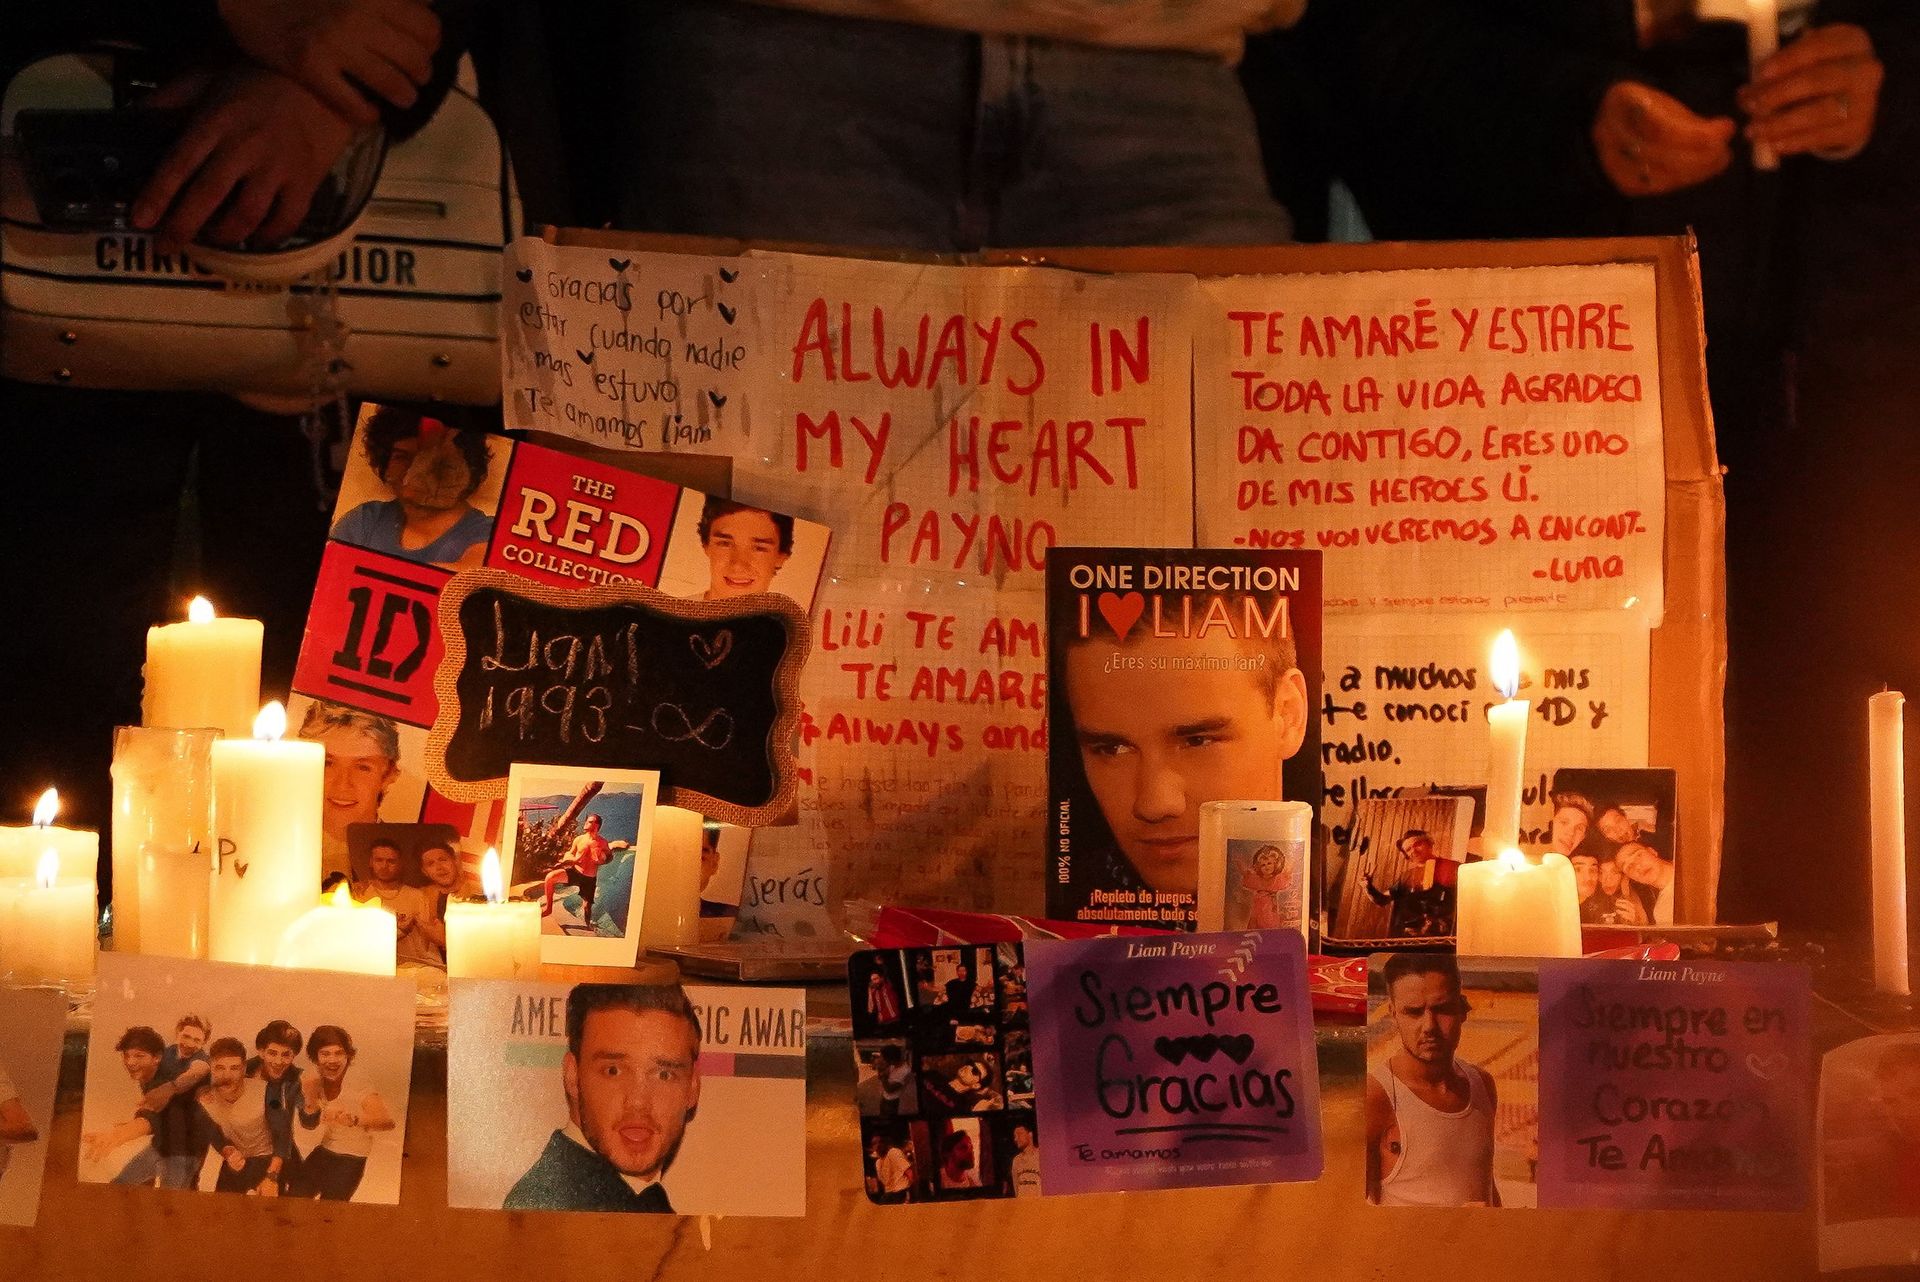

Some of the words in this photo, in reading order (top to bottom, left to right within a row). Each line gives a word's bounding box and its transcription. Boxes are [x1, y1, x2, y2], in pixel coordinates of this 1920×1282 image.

[548, 271, 634, 311] Gracias
[658, 289, 709, 321] por
[520, 302, 568, 336] estar
[1228, 312, 1285, 356] TE
[1300, 299, 1439, 357] AMARÉ
[1452, 308, 1478, 352] Y
[1489, 303, 1633, 354] ESTARE
[686, 337, 746, 371] nadie
[792, 298, 1045, 396] ALWAYS
[1090, 315, 1150, 396] IN
[535, 351, 573, 387] mas
[595, 369, 678, 403] estuvo
[1232, 371, 1331, 416] TODA
[1343, 377, 1384, 413] LA
[1397, 374, 1485, 409] VIDA
[525, 388, 554, 417] Te
[566, 403, 647, 448] amamos
[796, 410, 891, 485] MY
[949, 416, 1146, 496] HEART
[1238, 426, 1284, 464] DA
[1299, 426, 1472, 463] CONTIGO,
[1483, 426, 1554, 460] ERES
[572, 474, 615, 500] THE
[1238, 480, 1278, 510] DE
[1288, 478, 1355, 506] MIS
[1370, 476, 1489, 506] HEROES
[511, 486, 650, 564] RED
[881, 502, 1056, 575] PAYNO
[1510, 514, 1532, 541] A
[1069, 564, 1133, 589] ONE
[1144, 565, 1300, 591] DIRECTION
[906, 611, 956, 650] TE
[978, 616, 1041, 657] AM
[1079, 593, 1090, 639] I
[1153, 594, 1289, 639] LIAM
[1104, 652, 1144, 673] ¿Eres
[1150, 656, 1168, 670] su
[1234, 653, 1266, 671] fan?
[1340, 665, 1362, 691] a
[1375, 662, 1476, 691] muchos
[1544, 668, 1590, 690] mis
[841, 663, 898, 700] TE
[911, 667, 1047, 709] AMARE
[1588, 699, 1609, 729] y
[1060, 797, 1071, 836] OFICIAL
[1060, 838, 1071, 852] NO
[749, 868, 825, 907] serás
[1058, 855, 1071, 884] 100%
[1077, 906, 1159, 921] absolutamente
[1161, 907, 1185, 921] todo
[1090, 889, 1136, 907] ¡Repleto
[1139, 889, 1153, 904] de
[1127, 943, 1168, 959] Liam
[1171, 941, 1218, 959] Payne
[1638, 966, 1677, 982] Liam
[1681, 967, 1727, 985] Payne
[1075, 970, 1282, 1028] Siempre
[1574, 985, 1727, 1046] Siempre
[1743, 1006, 1786, 1034] en
[1096, 1033, 1295, 1119] Gracias
[1074, 1143, 1096, 1162] Te
[1101, 1146, 1181, 1160] amamos
[1577, 1134, 1627, 1170] Te
